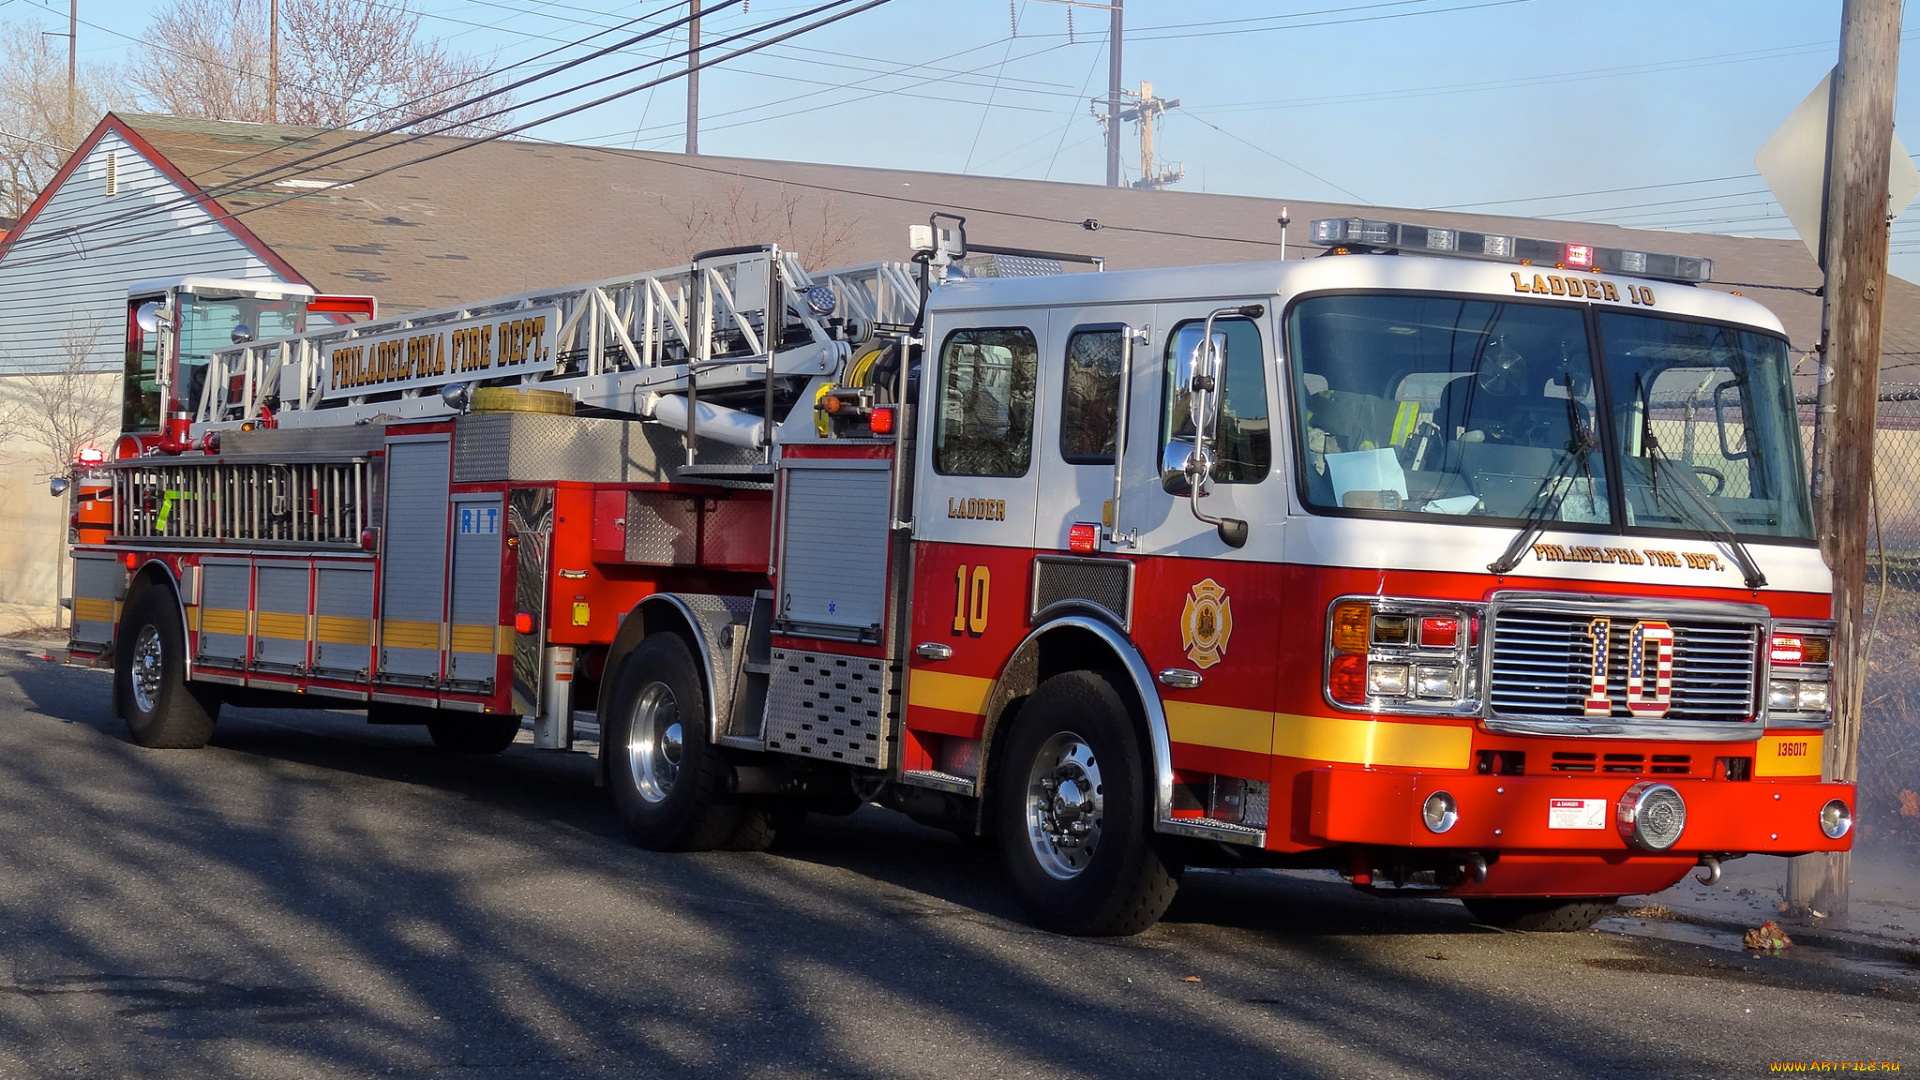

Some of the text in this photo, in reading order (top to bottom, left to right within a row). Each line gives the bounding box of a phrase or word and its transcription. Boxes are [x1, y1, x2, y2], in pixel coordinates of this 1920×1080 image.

[1511, 272, 1656, 306] LADDER 10
[331, 316, 549, 390] PHILADELPHIA FIRE DEPT.
[948, 497, 1006, 521] LADDER
[1533, 543, 1725, 572] PHILADELPHIA FIRE DEPT.
[785, 593, 791, 611] 2
[952, 564, 991, 638] 10
[318, 645, 322, 660] 8
[383, 650, 388, 665] 6
[1584, 618, 1675, 718] 10
[1778, 742, 1808, 757] 136017
